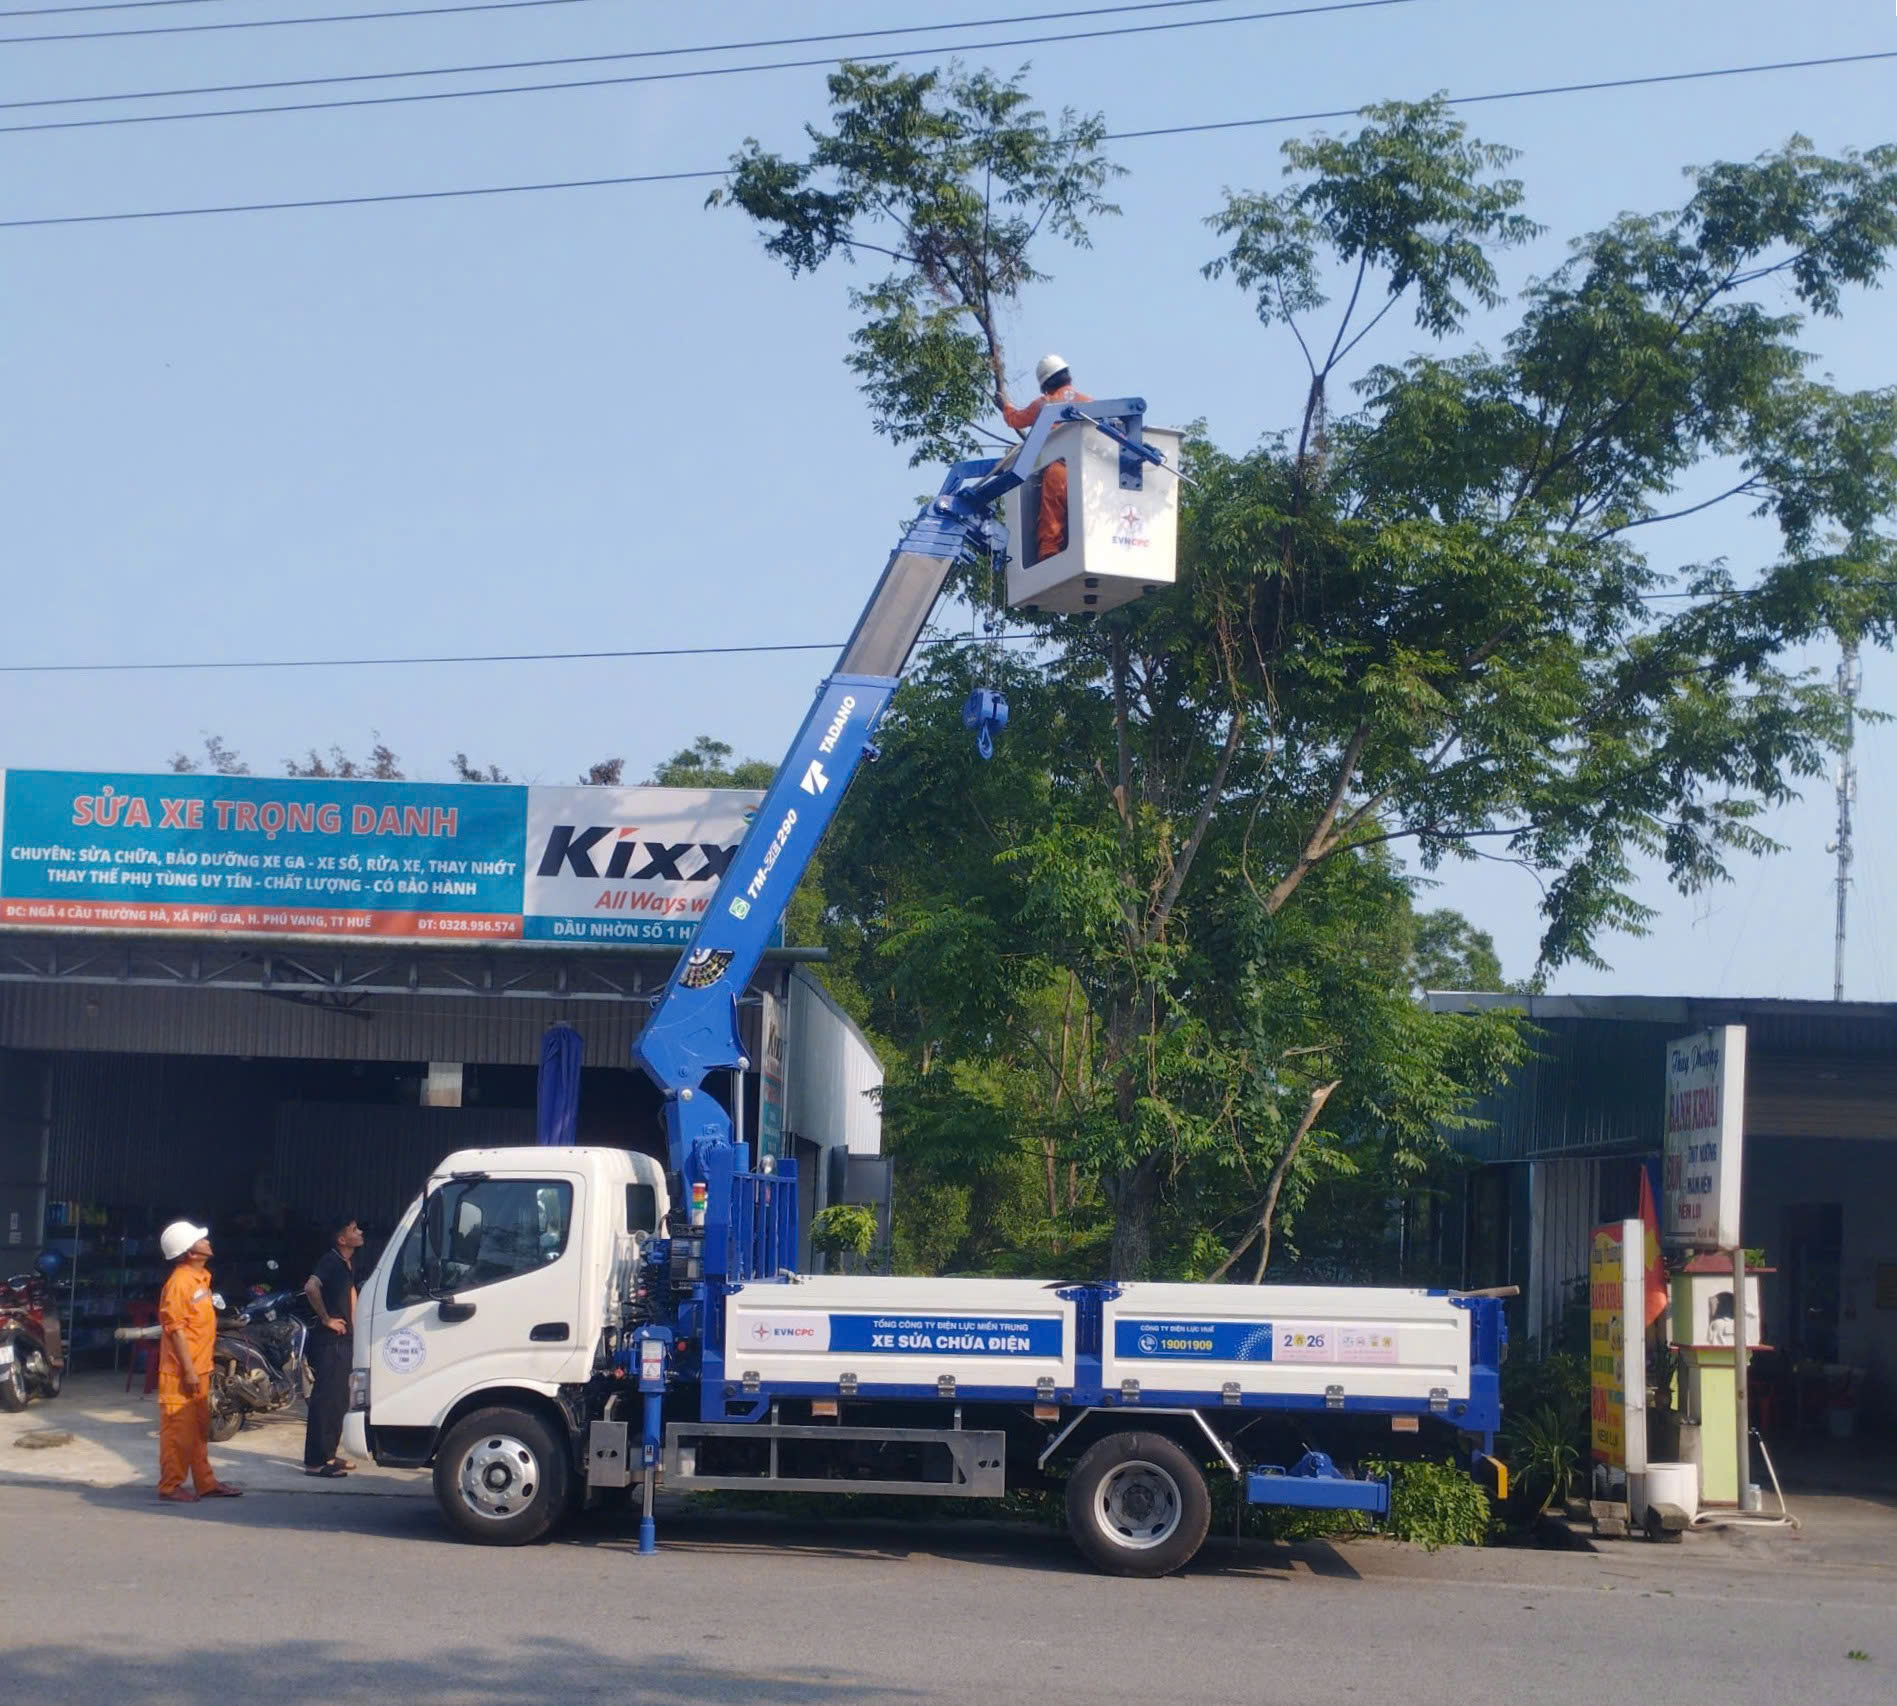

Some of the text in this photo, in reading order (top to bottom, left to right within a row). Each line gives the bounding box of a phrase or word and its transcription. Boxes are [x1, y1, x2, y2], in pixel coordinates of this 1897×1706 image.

[1112, 536, 1151, 548] EVNCPC
[818, 695, 856, 755] TADANO
[72, 784, 458, 840] SỬA XE TRỌNG DANH
[11, 844, 76, 862] CHUYÊN:
[79, 847, 112, 863] SỬA
[114, 848, 162, 866] CHỮA,
[166, 848, 198, 865] BẢO
[201, 849, 259, 868] DƯỠNG
[264, 855, 281, 868] XE
[284, 856, 305, 869] GA
[317, 857, 335, 870] XE
[338, 854, 362, 873] SỐ,
[366, 854, 399, 872] RỬA
[403, 860, 425, 875] XE,
[429, 860, 467, 874] THAY
[471, 858, 516, 876] NHỚT
[536, 825, 740, 882] Kixx
[48, 868, 87, 883] THAY
[90, 866, 120, 883] THẾ
[121, 871, 152, 889] PHỤ
[155, 869, 198, 887] TÙNG
[201, 874, 223, 888] UY
[225, 872, 252, 888] TÍN
[264, 875, 302, 890] CHẤT
[306, 876, 361, 895] LƯỢNG
[373, 877, 394, 893] CÓ
[397, 877, 428, 894] BẢO
[433, 880, 477, 895] HÀNH
[594, 890, 629, 910] All
[631, 891, 687, 916] Ways
[57, 907, 65, 917] 4
[248, 913, 260, 925] H.
[330, 915, 344, 928] TT
[347, 913, 373, 928] HUẾ
[439, 919, 516, 932] 0328.956.574
[590, 921, 638, 938] NHỜN
[642, 922, 662, 938] SỐ
[667, 927, 674, 939] 1
[774, 1329, 814, 1337] EVNCPC
[925, 1321, 935, 1329] TY
[1000, 1323, 1029, 1332] TRUNG
[872, 1331, 1030, 1353] XE SỬA CHỮA ĐIỆN
[1161, 1339, 1213, 1351] 19001909
